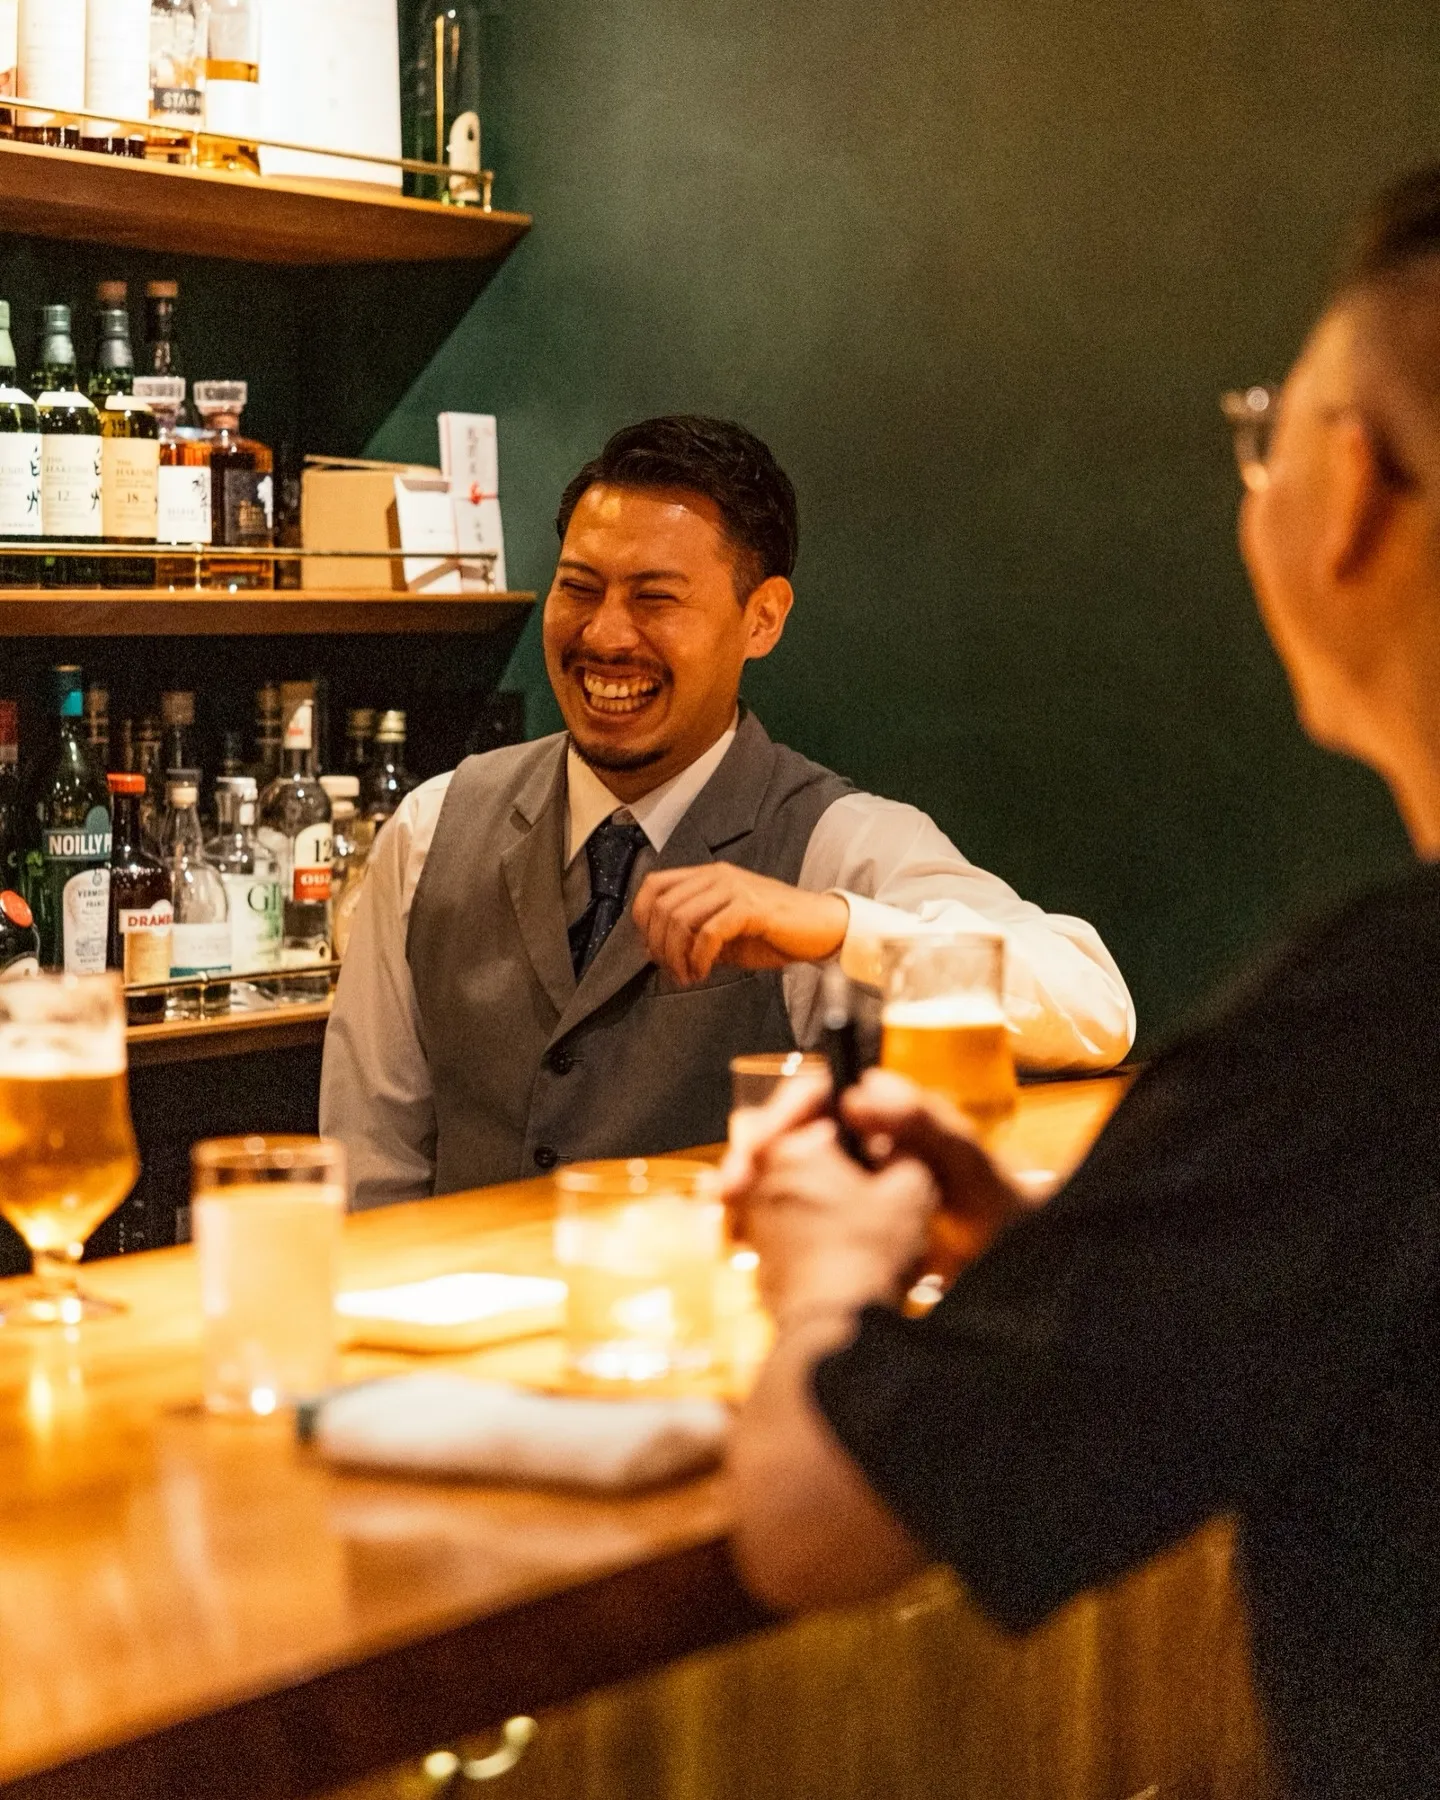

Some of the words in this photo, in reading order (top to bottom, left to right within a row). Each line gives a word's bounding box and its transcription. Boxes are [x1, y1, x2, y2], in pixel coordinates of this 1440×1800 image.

[57, 490, 70, 501] 12
[127, 492, 138, 503] 18
[49, 833, 103, 855] NOILLY
[315, 838, 331, 862] 12
